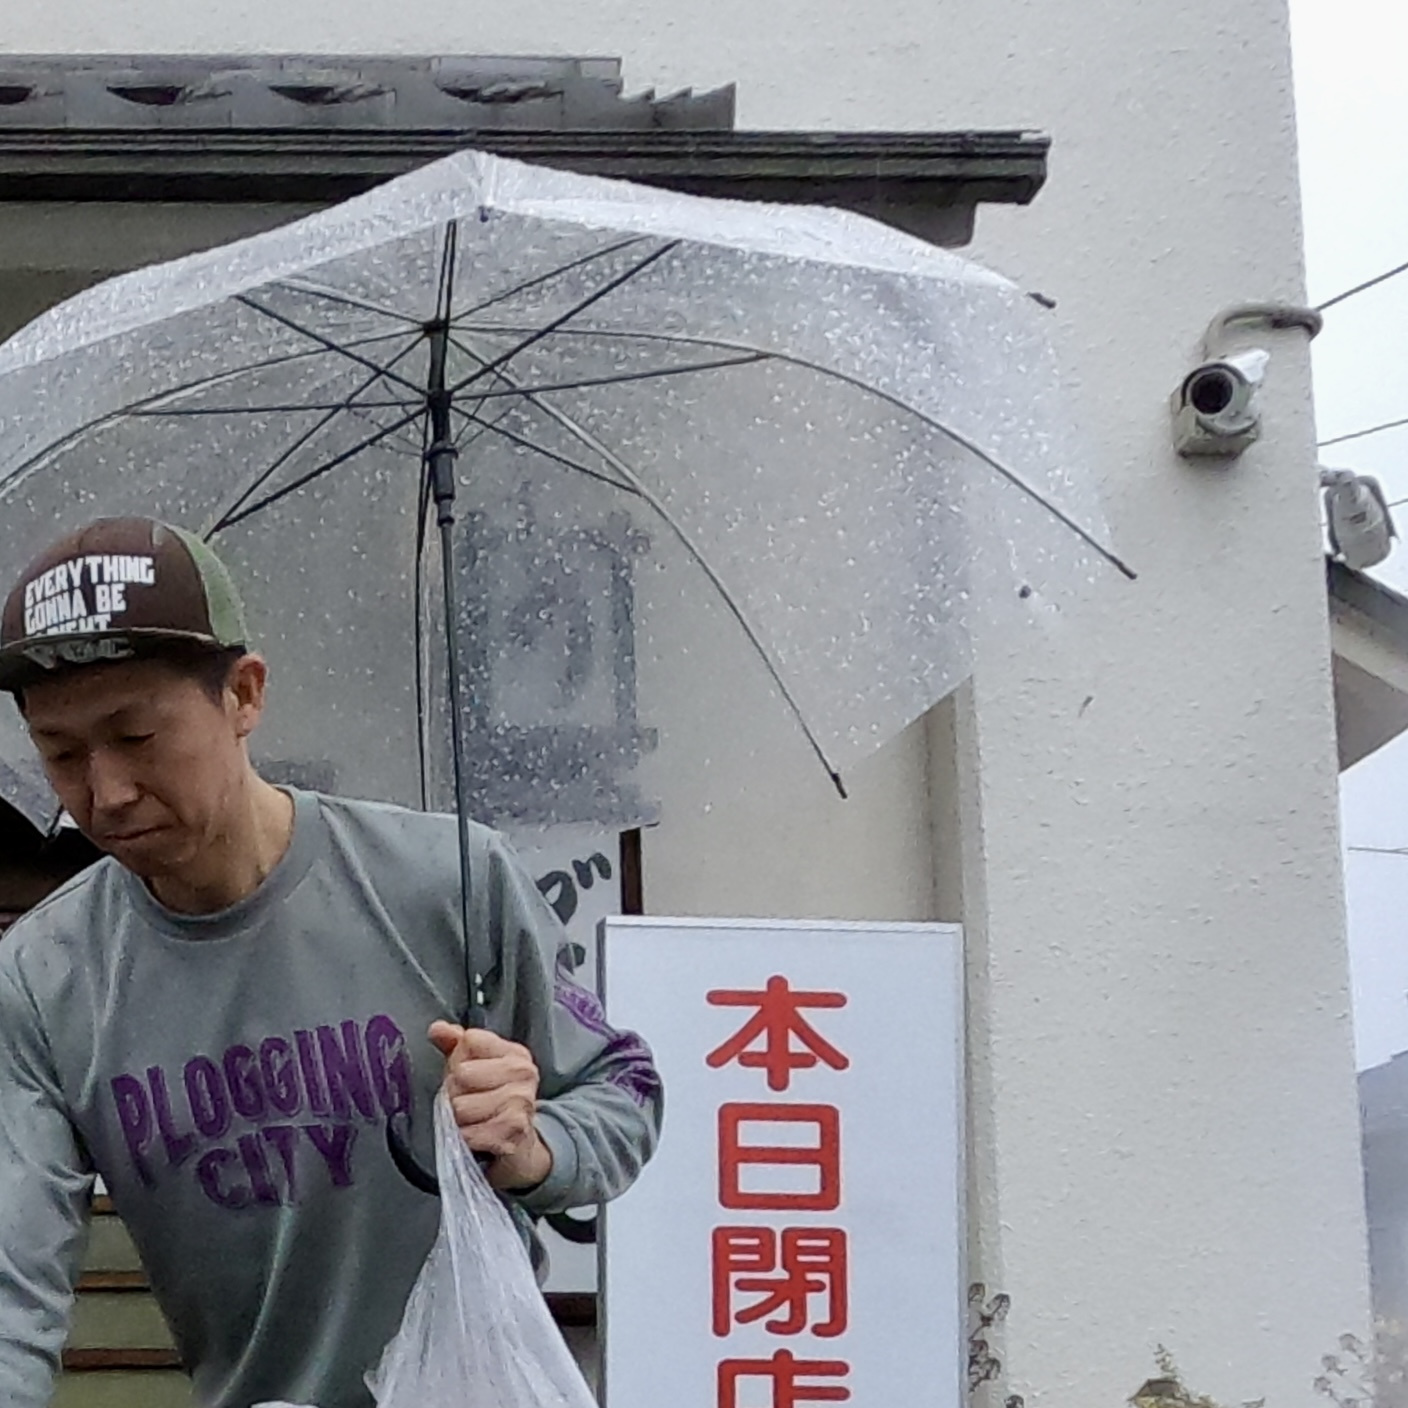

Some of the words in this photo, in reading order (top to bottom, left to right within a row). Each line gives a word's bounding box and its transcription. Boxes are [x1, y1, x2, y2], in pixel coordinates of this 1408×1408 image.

[24, 555, 155, 609] EVERYTHING
[25, 588, 87, 636] GONNA
[95, 583, 126, 613] BE
[111, 1014, 414, 1188] PLOGGING
[197, 1125, 359, 1209] CITY
